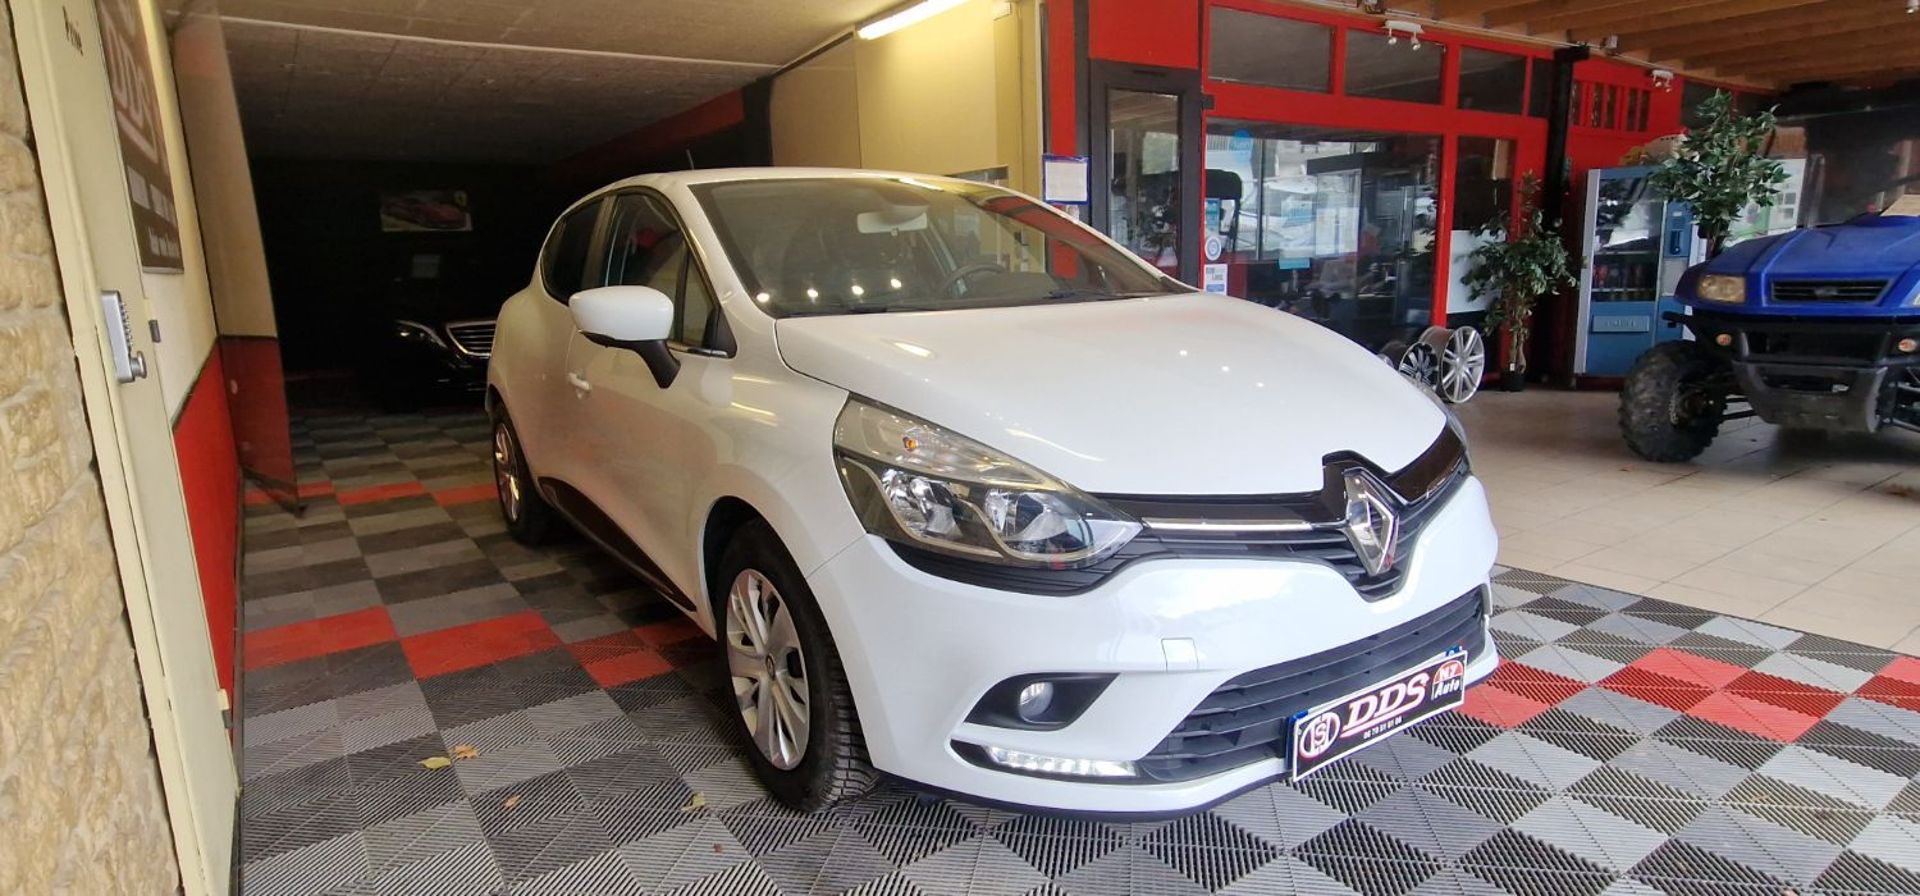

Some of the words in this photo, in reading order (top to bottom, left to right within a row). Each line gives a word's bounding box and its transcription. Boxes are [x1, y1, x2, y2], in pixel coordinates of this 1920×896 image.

[1439, 666, 1458, 680] N7
[1434, 680, 1460, 698] Auto
[1340, 673, 1430, 738] DDS
